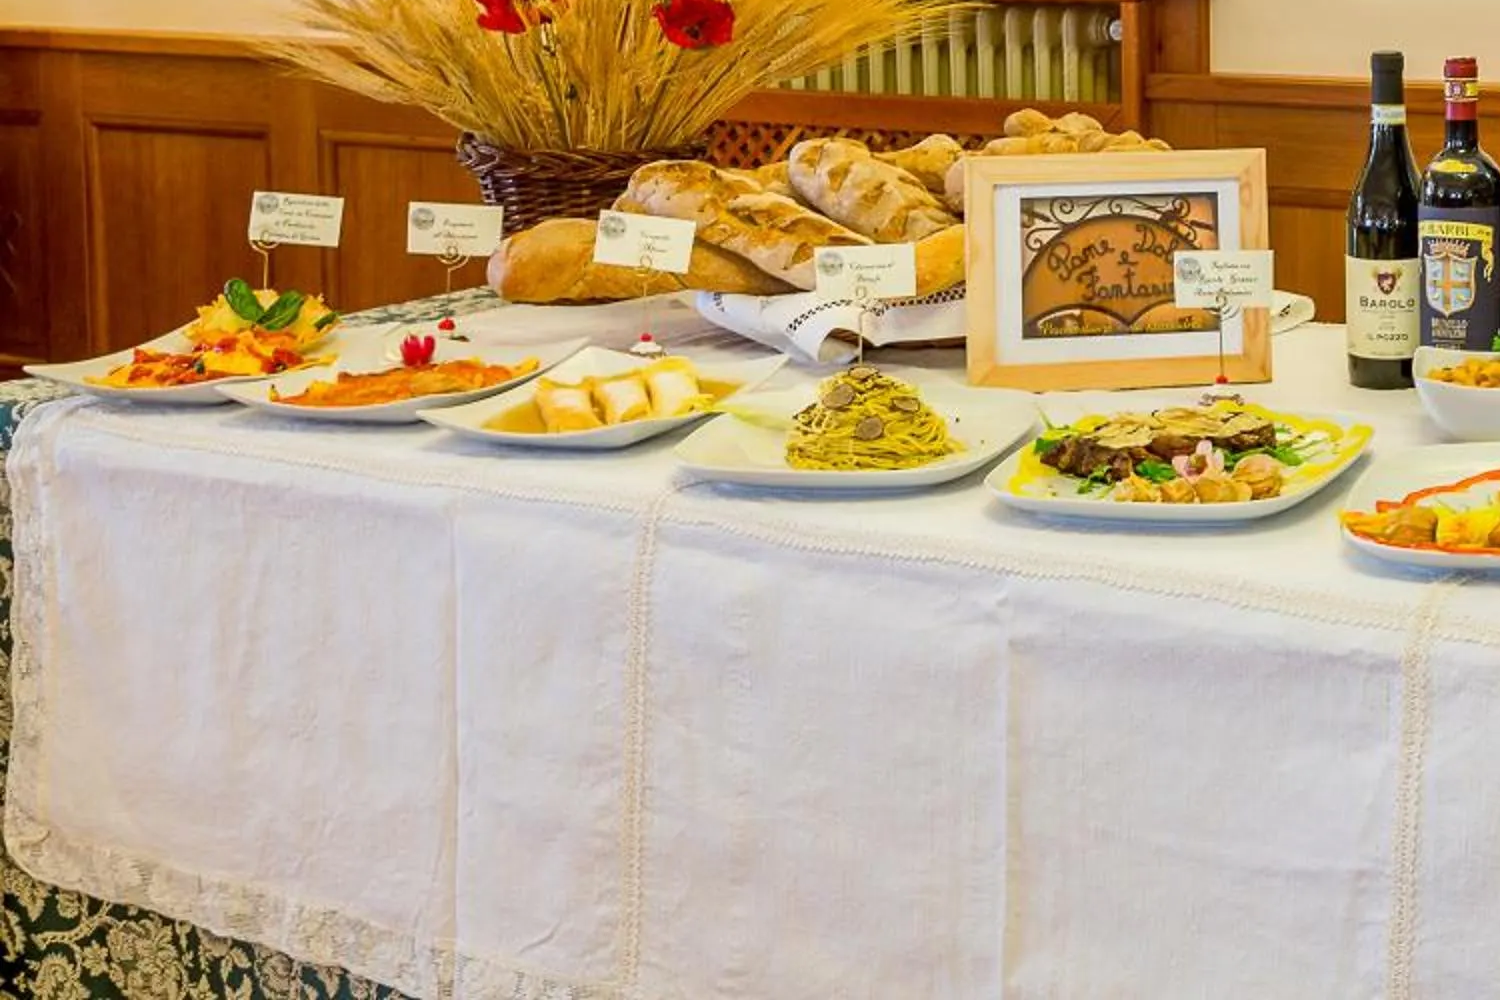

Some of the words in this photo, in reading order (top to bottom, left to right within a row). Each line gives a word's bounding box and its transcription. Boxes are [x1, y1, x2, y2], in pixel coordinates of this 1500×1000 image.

[1047, 237, 1116, 282] Pane
[1118, 250, 1138, 266] e
[1132, 223, 1174, 266] Dol
[1360, 295, 1415, 309] BAROLO
